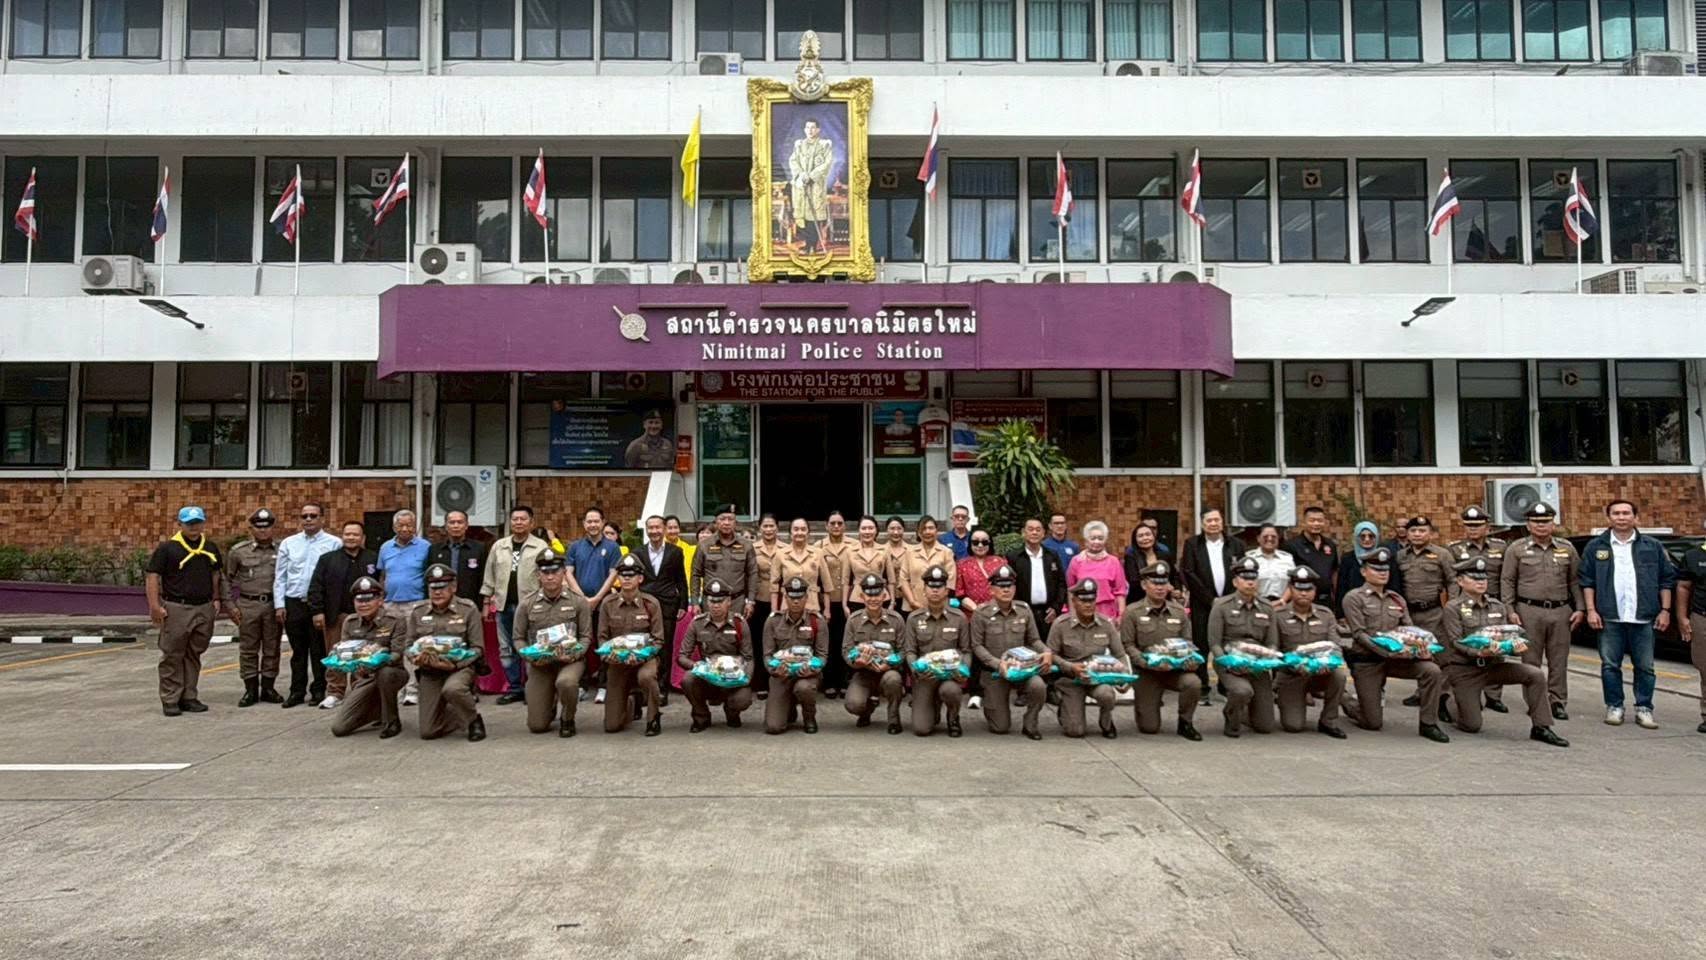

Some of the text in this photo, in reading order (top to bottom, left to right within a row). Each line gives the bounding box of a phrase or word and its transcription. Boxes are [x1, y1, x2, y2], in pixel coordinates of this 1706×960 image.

[666, 309, 976, 334] สถานีตำรวจนครบาลนิมิตรใหม่
[702, 341, 943, 359] Nimitmai Police Station
[730, 370, 896, 386] โรงพักเพือประชาชน
[740, 387, 884, 397] THE STATION FOR THE PUBLIC
